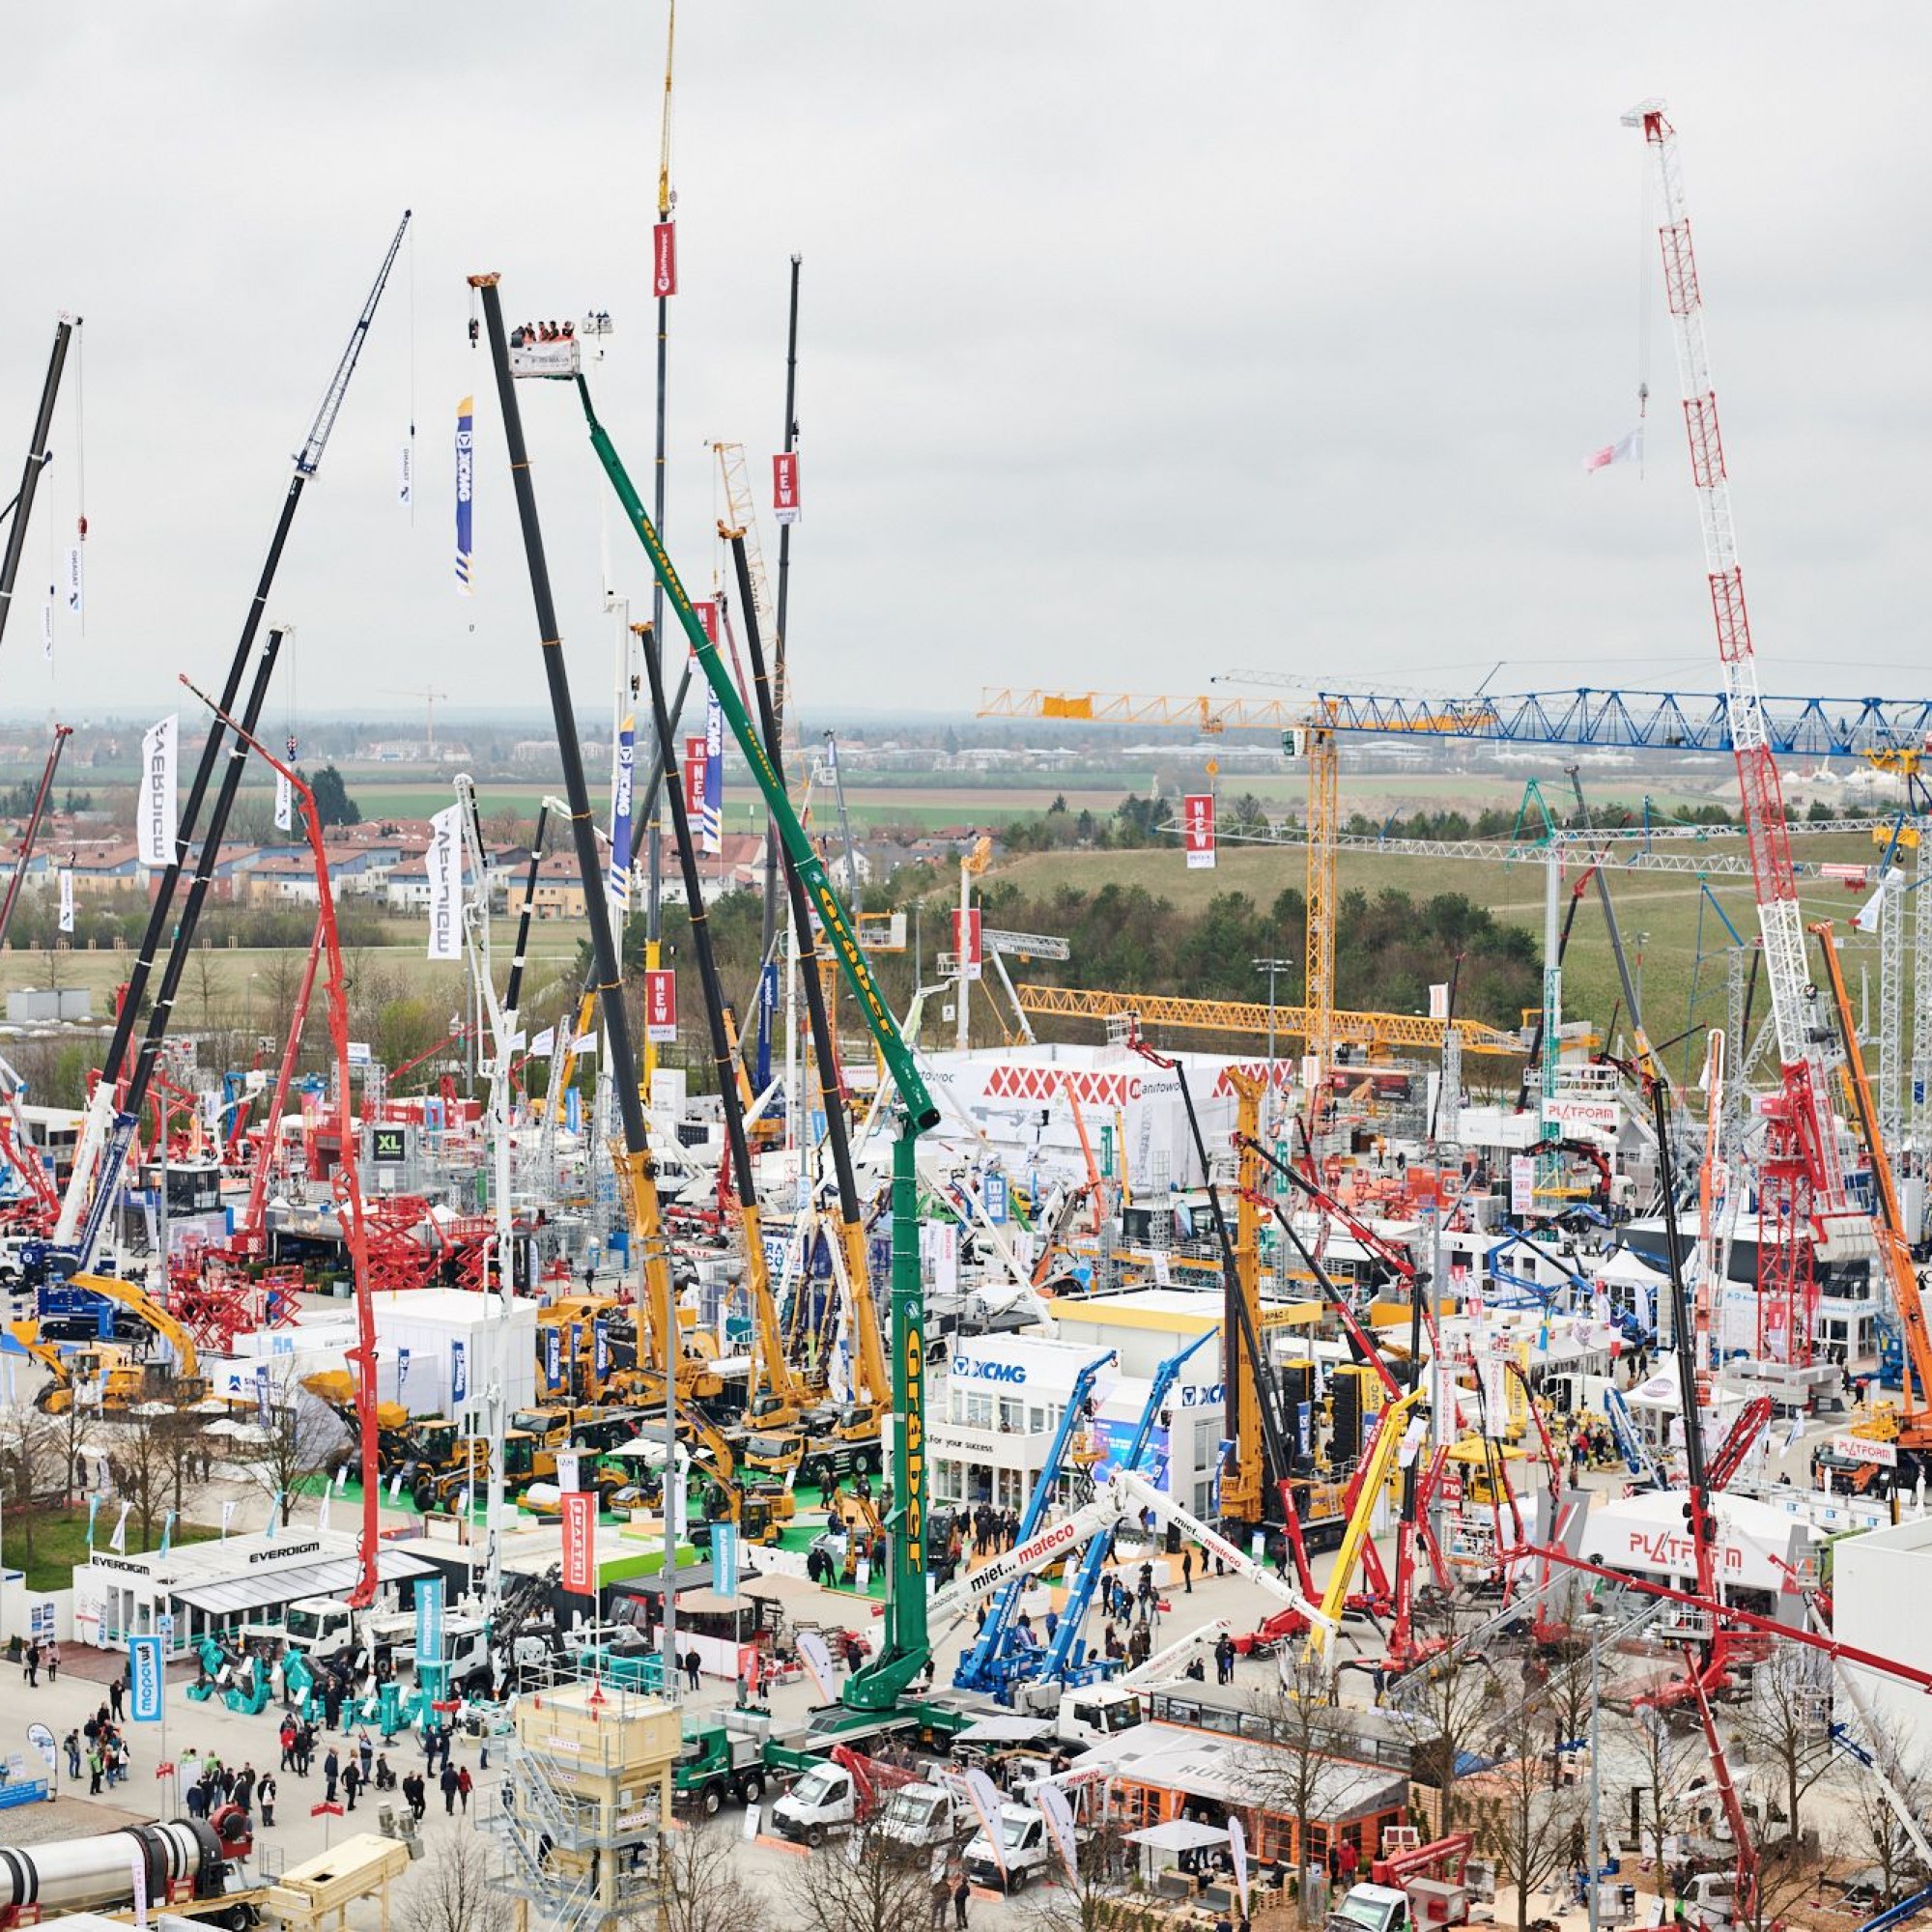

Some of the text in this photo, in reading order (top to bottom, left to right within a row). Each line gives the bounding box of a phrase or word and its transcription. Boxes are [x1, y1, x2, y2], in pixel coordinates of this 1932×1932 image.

[457, 451, 471, 502] XCMG
[779, 458, 792, 504] NEW
[707, 706, 721, 756] XCMG
[617, 766, 631, 817] XCMG
[1194, 801, 1208, 847] NEW
[654, 976, 668, 1022] NEW
[1548, 1104, 1614, 1121] PLATFORM
[378, 1135, 402, 1151] XL
[972, 1360, 1027, 1383] XCMG
[929, 1435, 942, 1444] For
[249, 1541, 320, 1563] EVERDIGM
[1018, 1523, 1075, 1564] mateco
[92, 1555, 151, 1576] EVERDIGM
